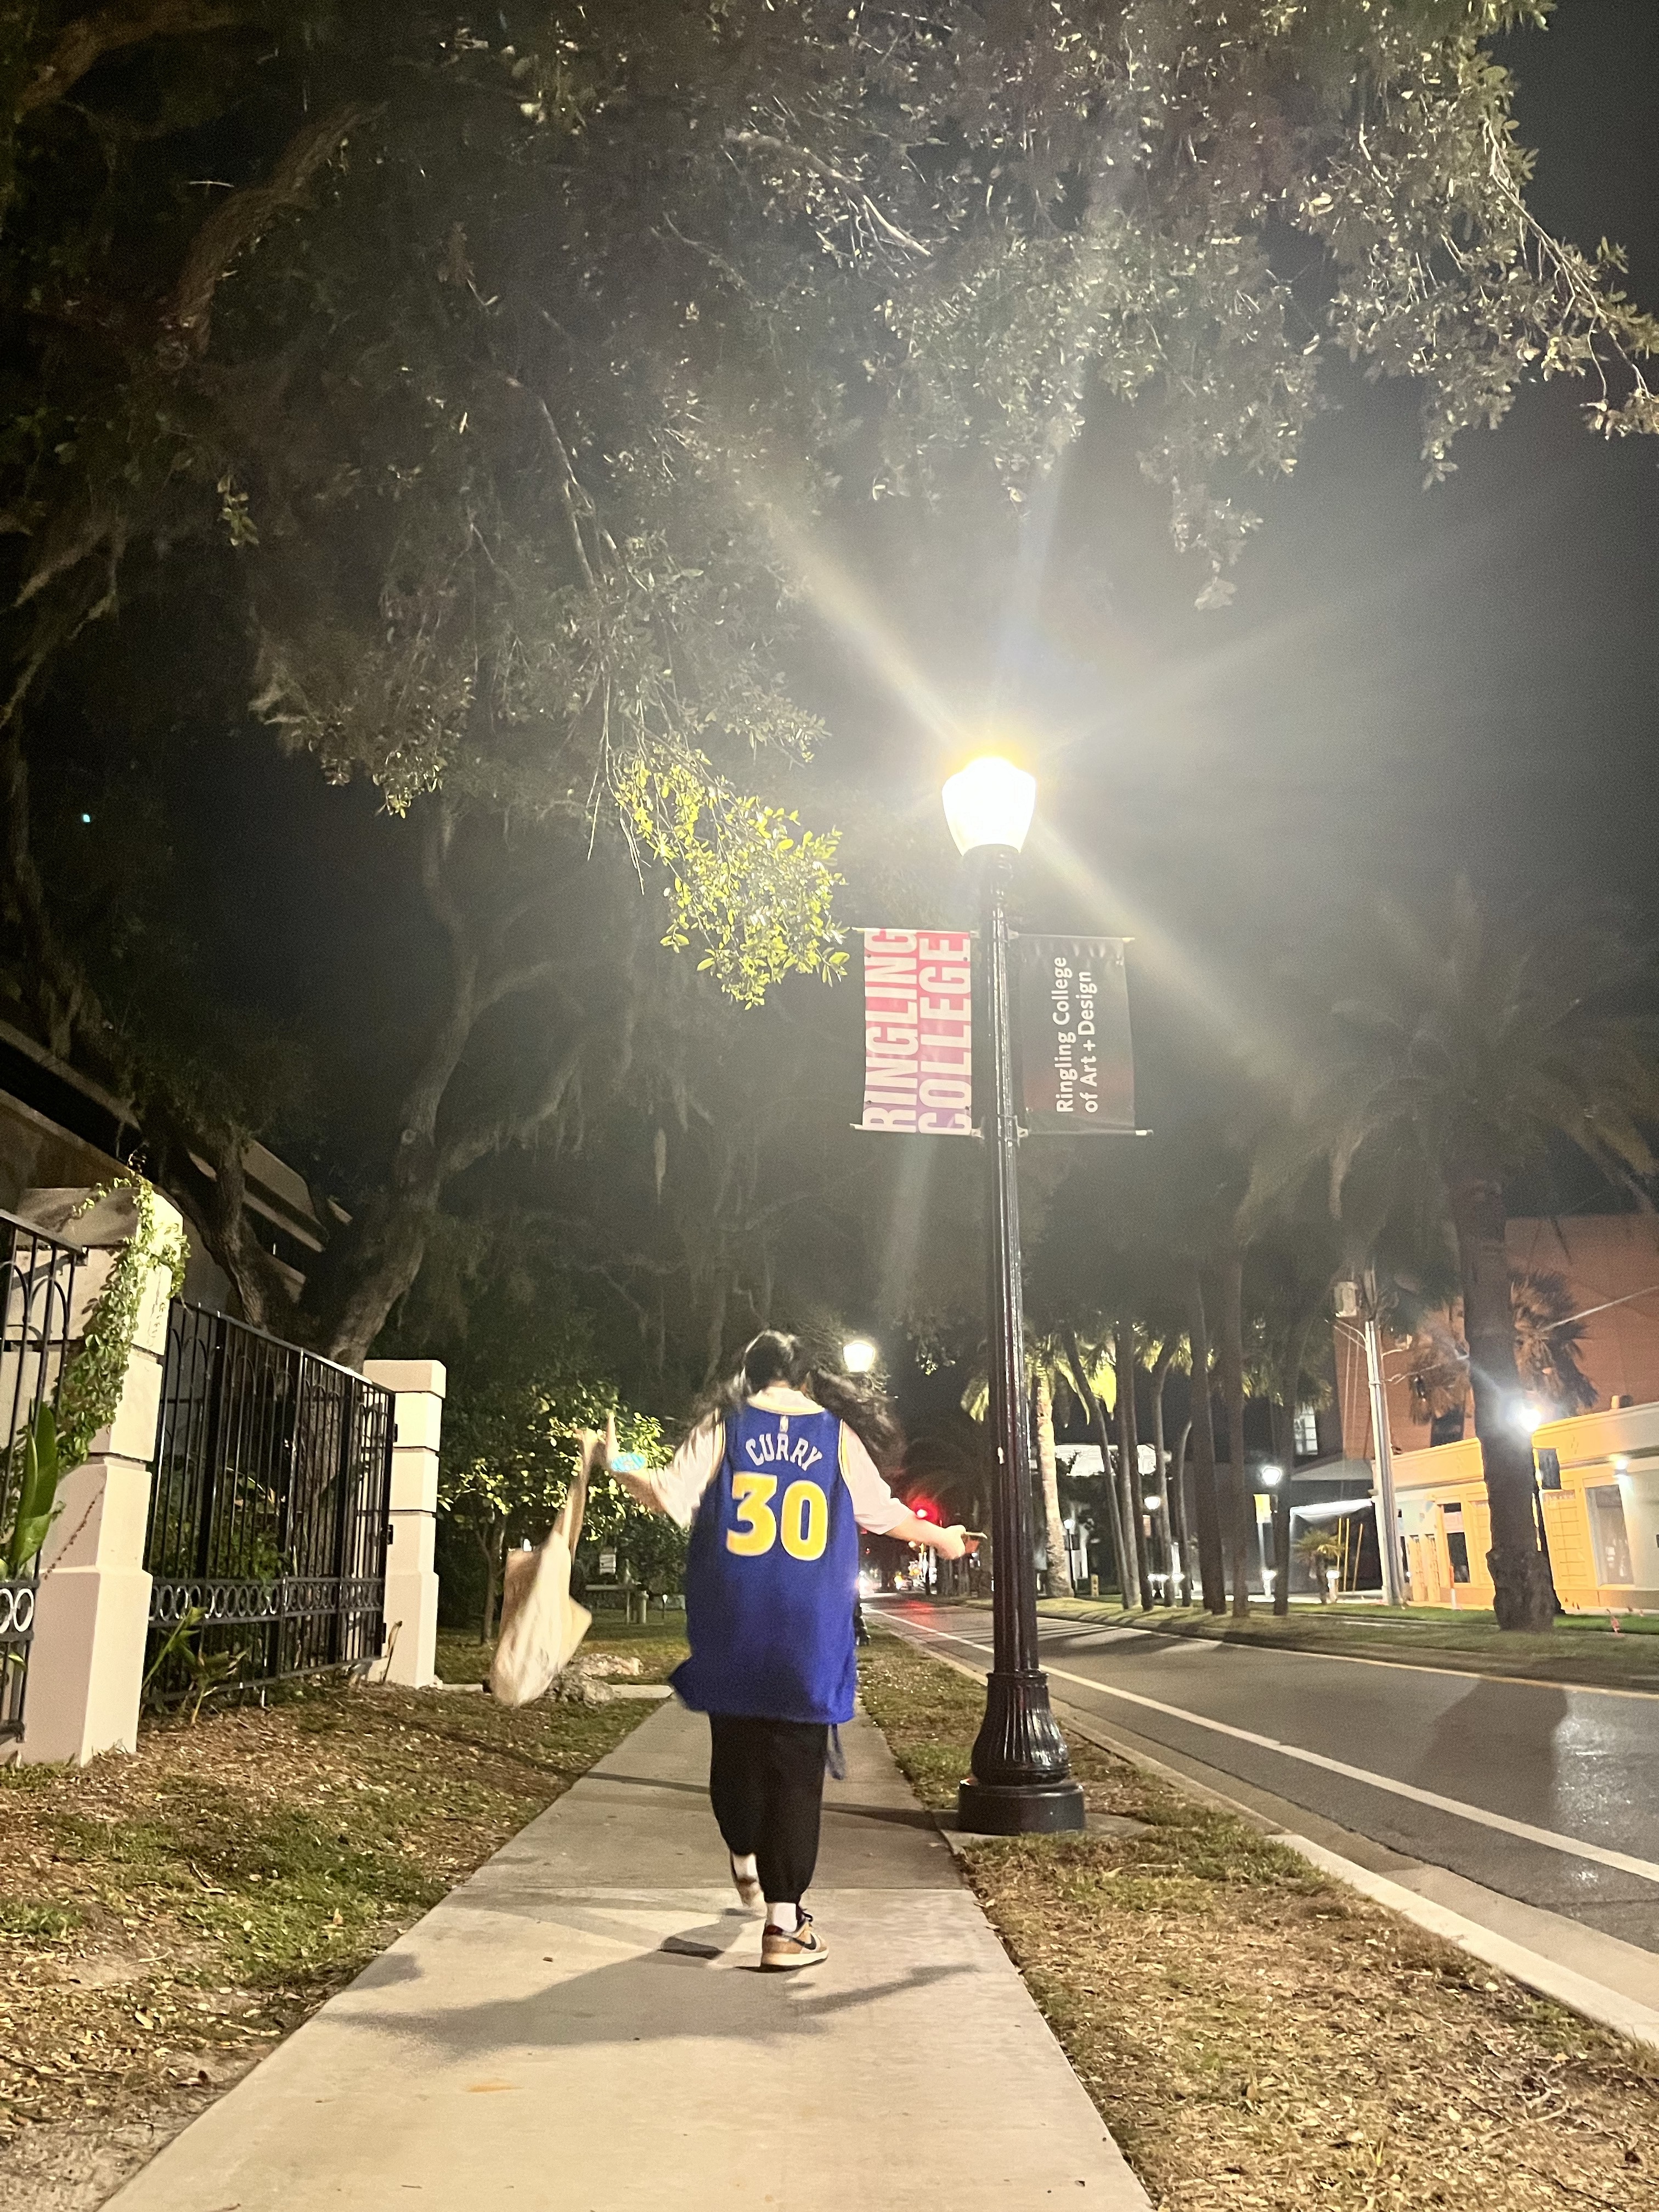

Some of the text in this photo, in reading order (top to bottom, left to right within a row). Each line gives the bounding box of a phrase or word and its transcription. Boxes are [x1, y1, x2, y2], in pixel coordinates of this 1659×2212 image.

[862, 928, 919, 1133] RINGLING
[918, 938, 972, 1135] COLLEGE
[1051, 957, 1078, 1112] Ringling College
[1075, 972, 1098, 1113] of Art + Design
[726, 1471, 828, 1561] 30
[745, 1433, 822, 1471] CURRY
